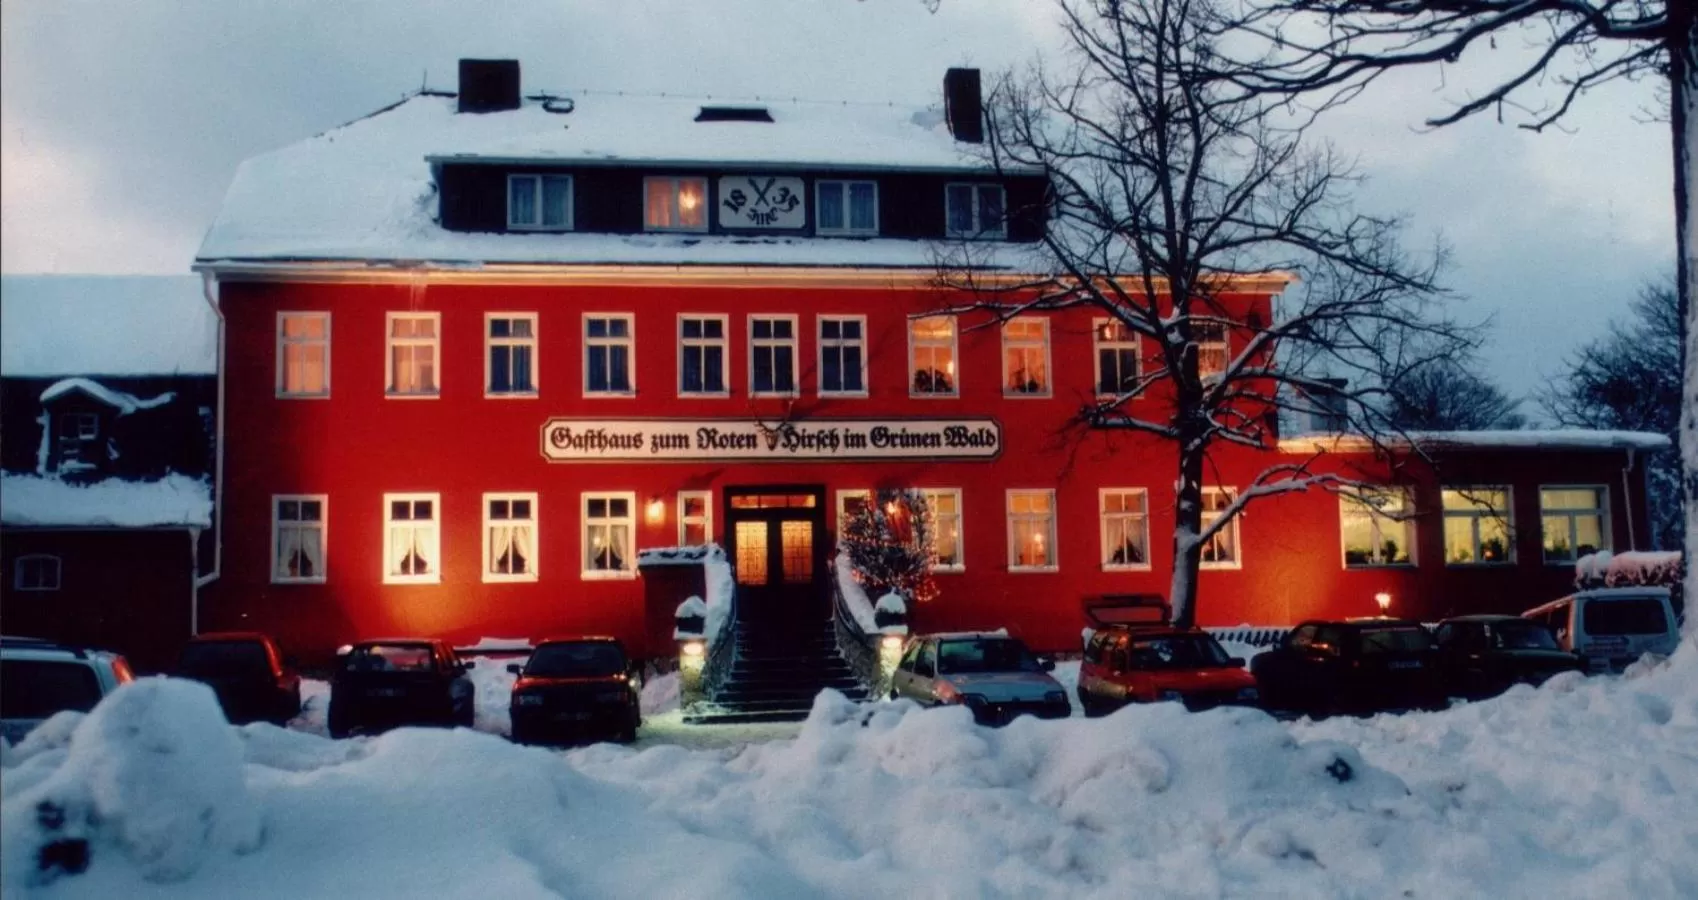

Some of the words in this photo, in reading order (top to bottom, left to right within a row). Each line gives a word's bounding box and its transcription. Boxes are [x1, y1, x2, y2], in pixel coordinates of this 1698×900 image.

[550, 427, 643, 453] Gasthaus
[650, 432, 690, 453] zum
[696, 427, 758, 450] Roten
[781, 426, 840, 453] Hirsch
[843, 428, 867, 449] im
[870, 426, 941, 449] Grünen
[943, 426, 996, 448] Wald
